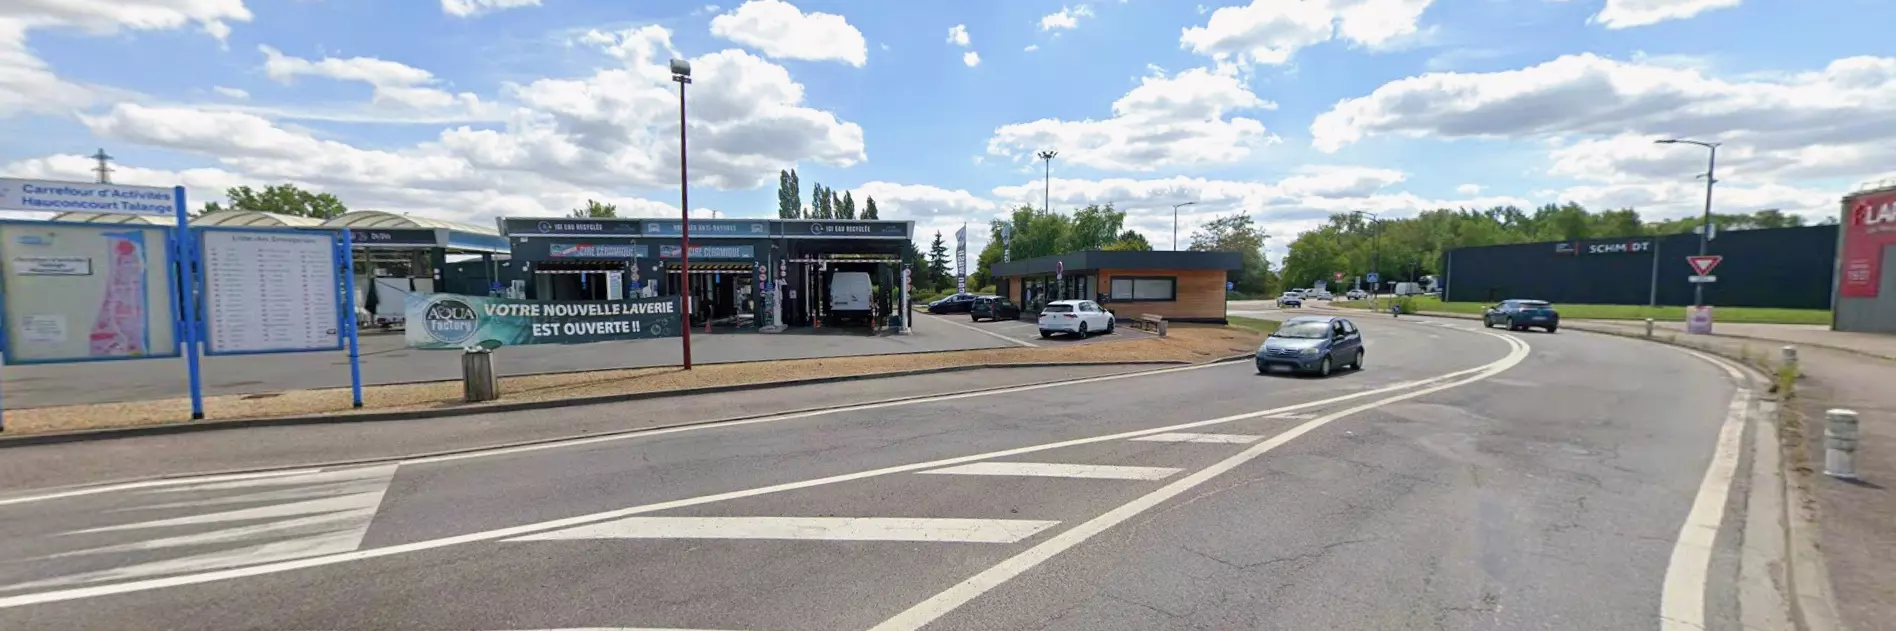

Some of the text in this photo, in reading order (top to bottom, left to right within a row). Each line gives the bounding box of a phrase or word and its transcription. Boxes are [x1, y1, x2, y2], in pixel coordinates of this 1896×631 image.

[23, 183, 94, 197] Carrefour
[22, 196, 172, 214] Hauconcourt Talange
[825, 225, 834, 233] ICI
[835, 225, 846, 233] EAU
[427, 305, 475, 323] AQUA
[484, 301, 674, 317] VOTRE NOUVELLE LAVERIE
[532, 320, 641, 337] EST OUVERTE !!
